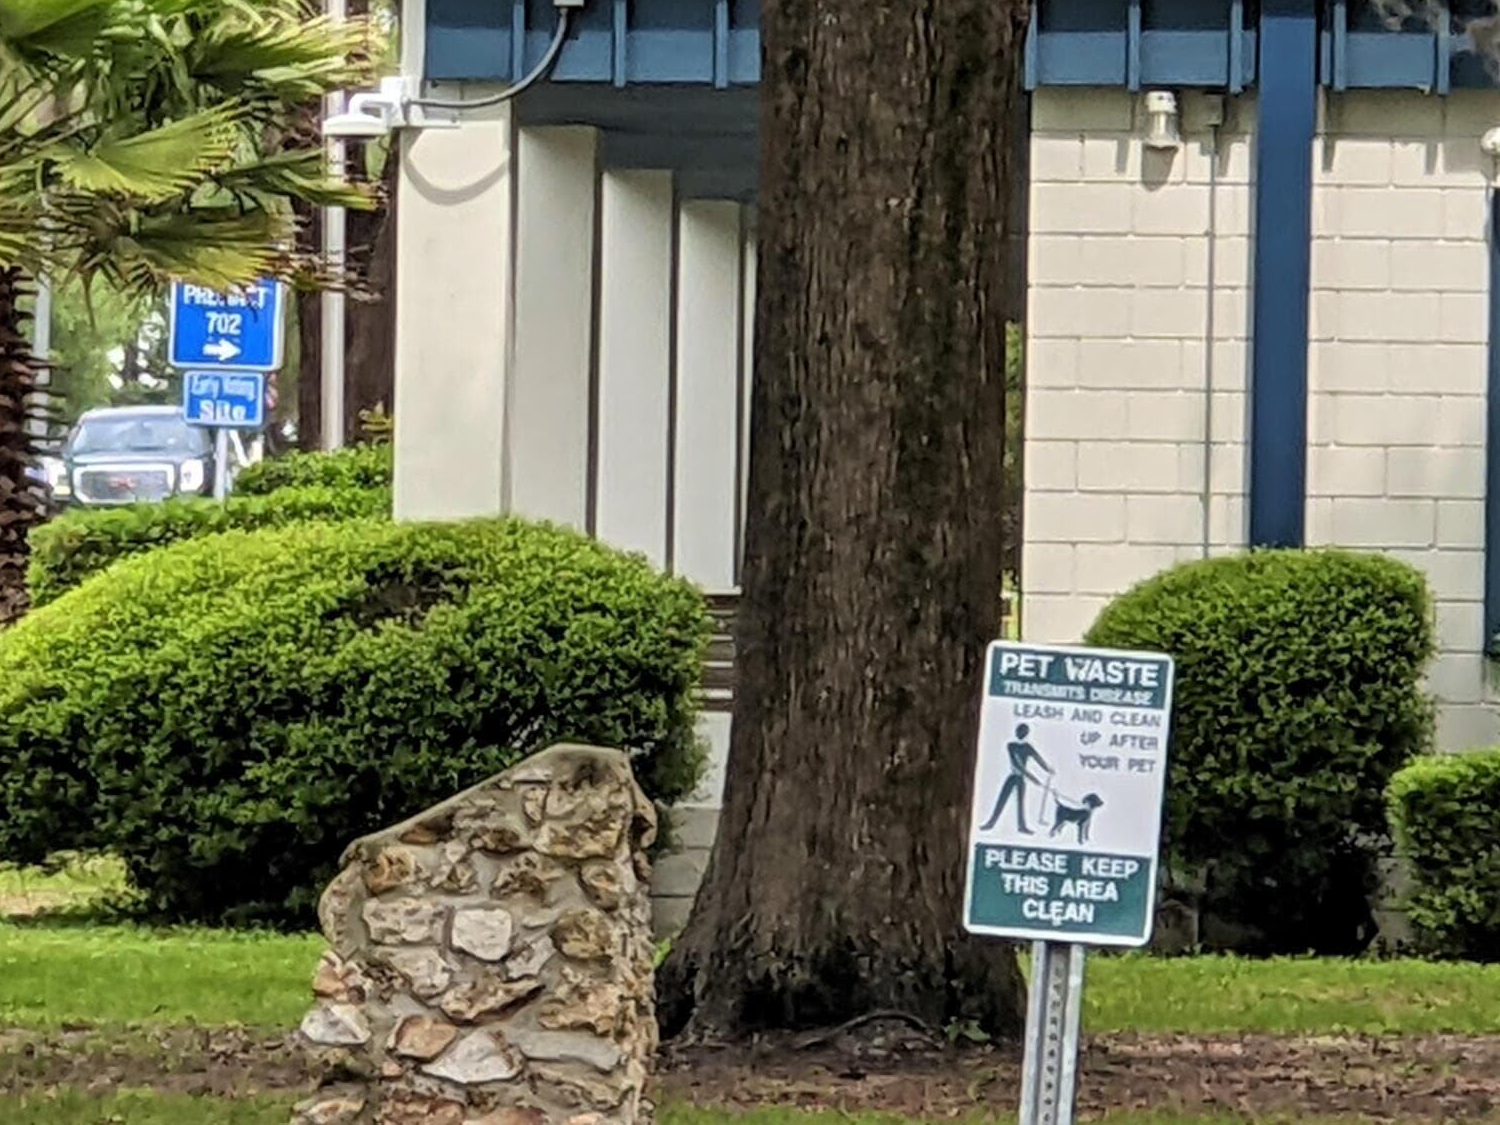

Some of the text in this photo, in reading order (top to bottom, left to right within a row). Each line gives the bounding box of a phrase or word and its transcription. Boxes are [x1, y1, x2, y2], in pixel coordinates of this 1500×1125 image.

[205, 311, 242, 335] 702
[1000, 651, 1159, 687] PET WASTE
[1003, 680, 1154, 705] TRANSMITS DISEASE
[1012, 703, 1162, 727] LEASH AND CLEAN
[1079, 731, 1159, 751] UP AFTER
[1079, 753, 1157, 773] YOUR PET
[985, 848, 1140, 879] PLEASE KEEP
[1001, 873, 1119, 901] THIS AREA
[1022, 899, 1095, 925] CLEAN
